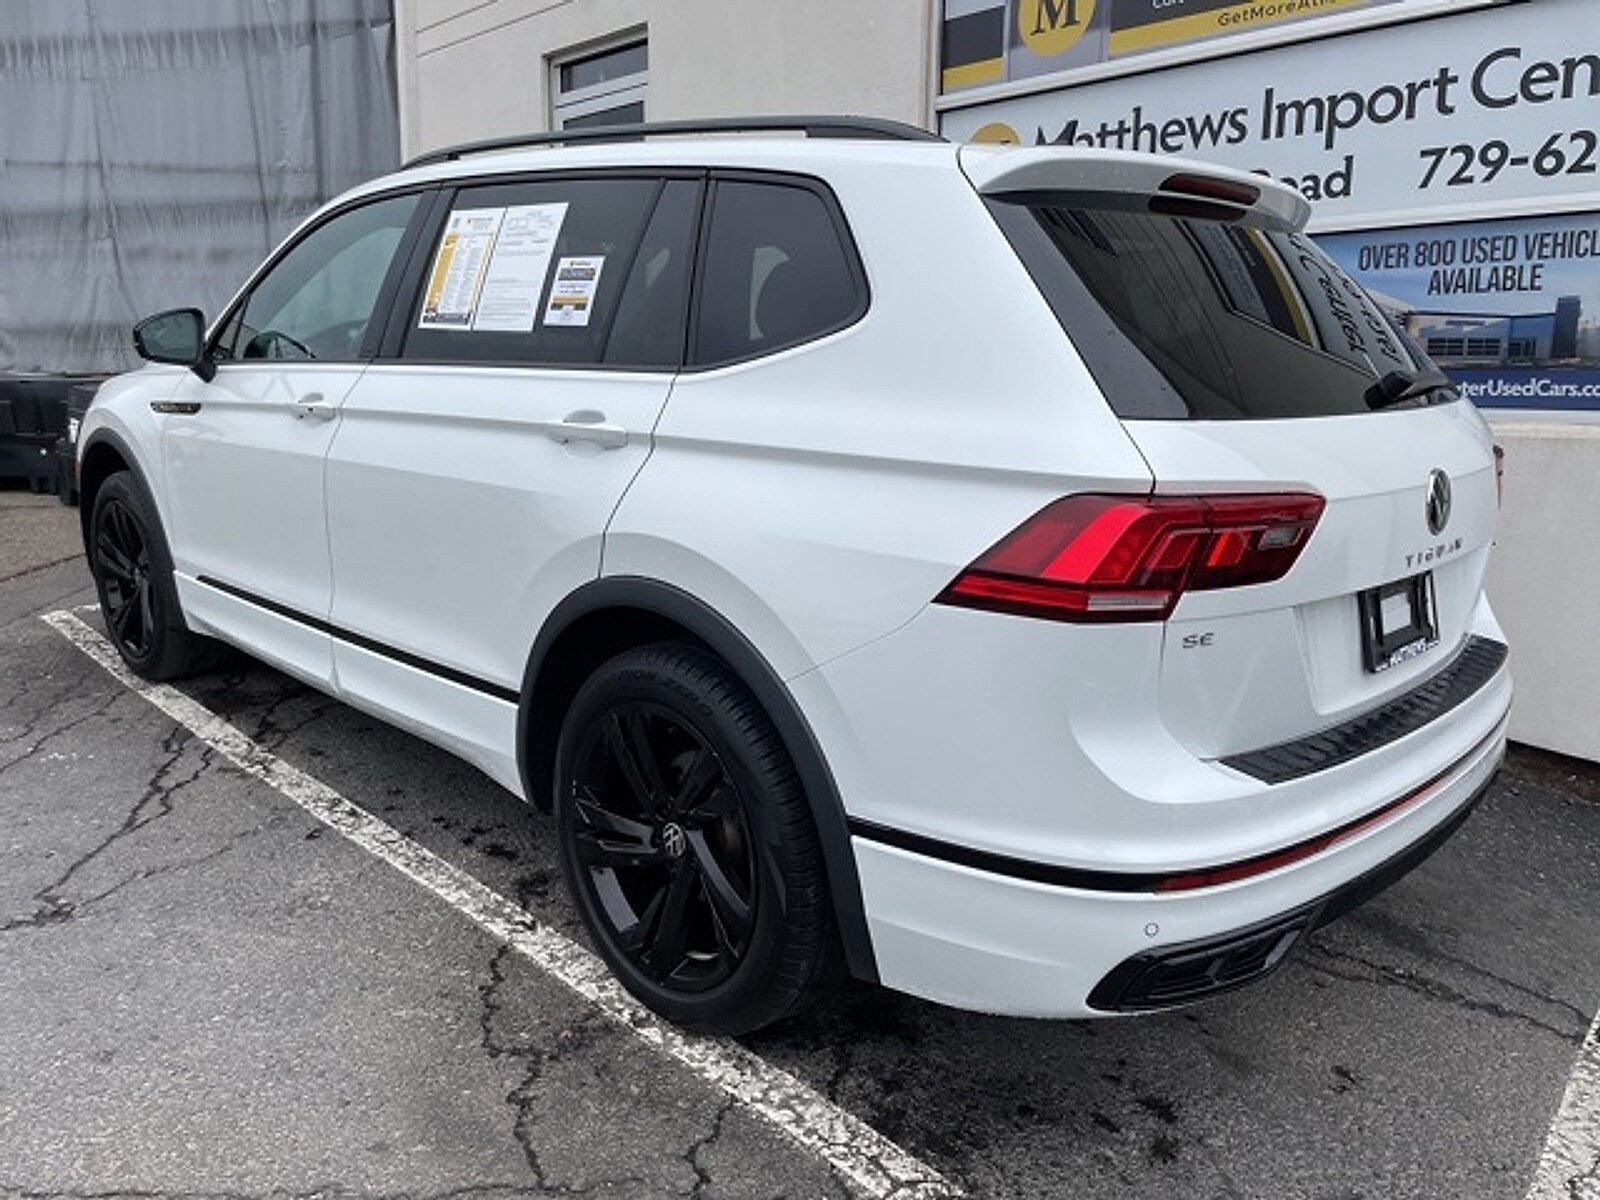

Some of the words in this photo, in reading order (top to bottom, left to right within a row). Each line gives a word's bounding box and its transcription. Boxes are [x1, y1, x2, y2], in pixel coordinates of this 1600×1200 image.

[1260, 66, 1460, 151] Import
[1471, 46, 1600, 109] Cen
[1417, 129, 1598, 190] 729-62
[1358, 241, 1409, 272] OVER
[1414, 239, 1457, 268] 800
[1462, 234, 1518, 265] USED
[1525, 229, 1600, 262] VEHICL
[1427, 262, 1545, 297] AVAILABLE
[1182, 632, 1215, 649] SE
